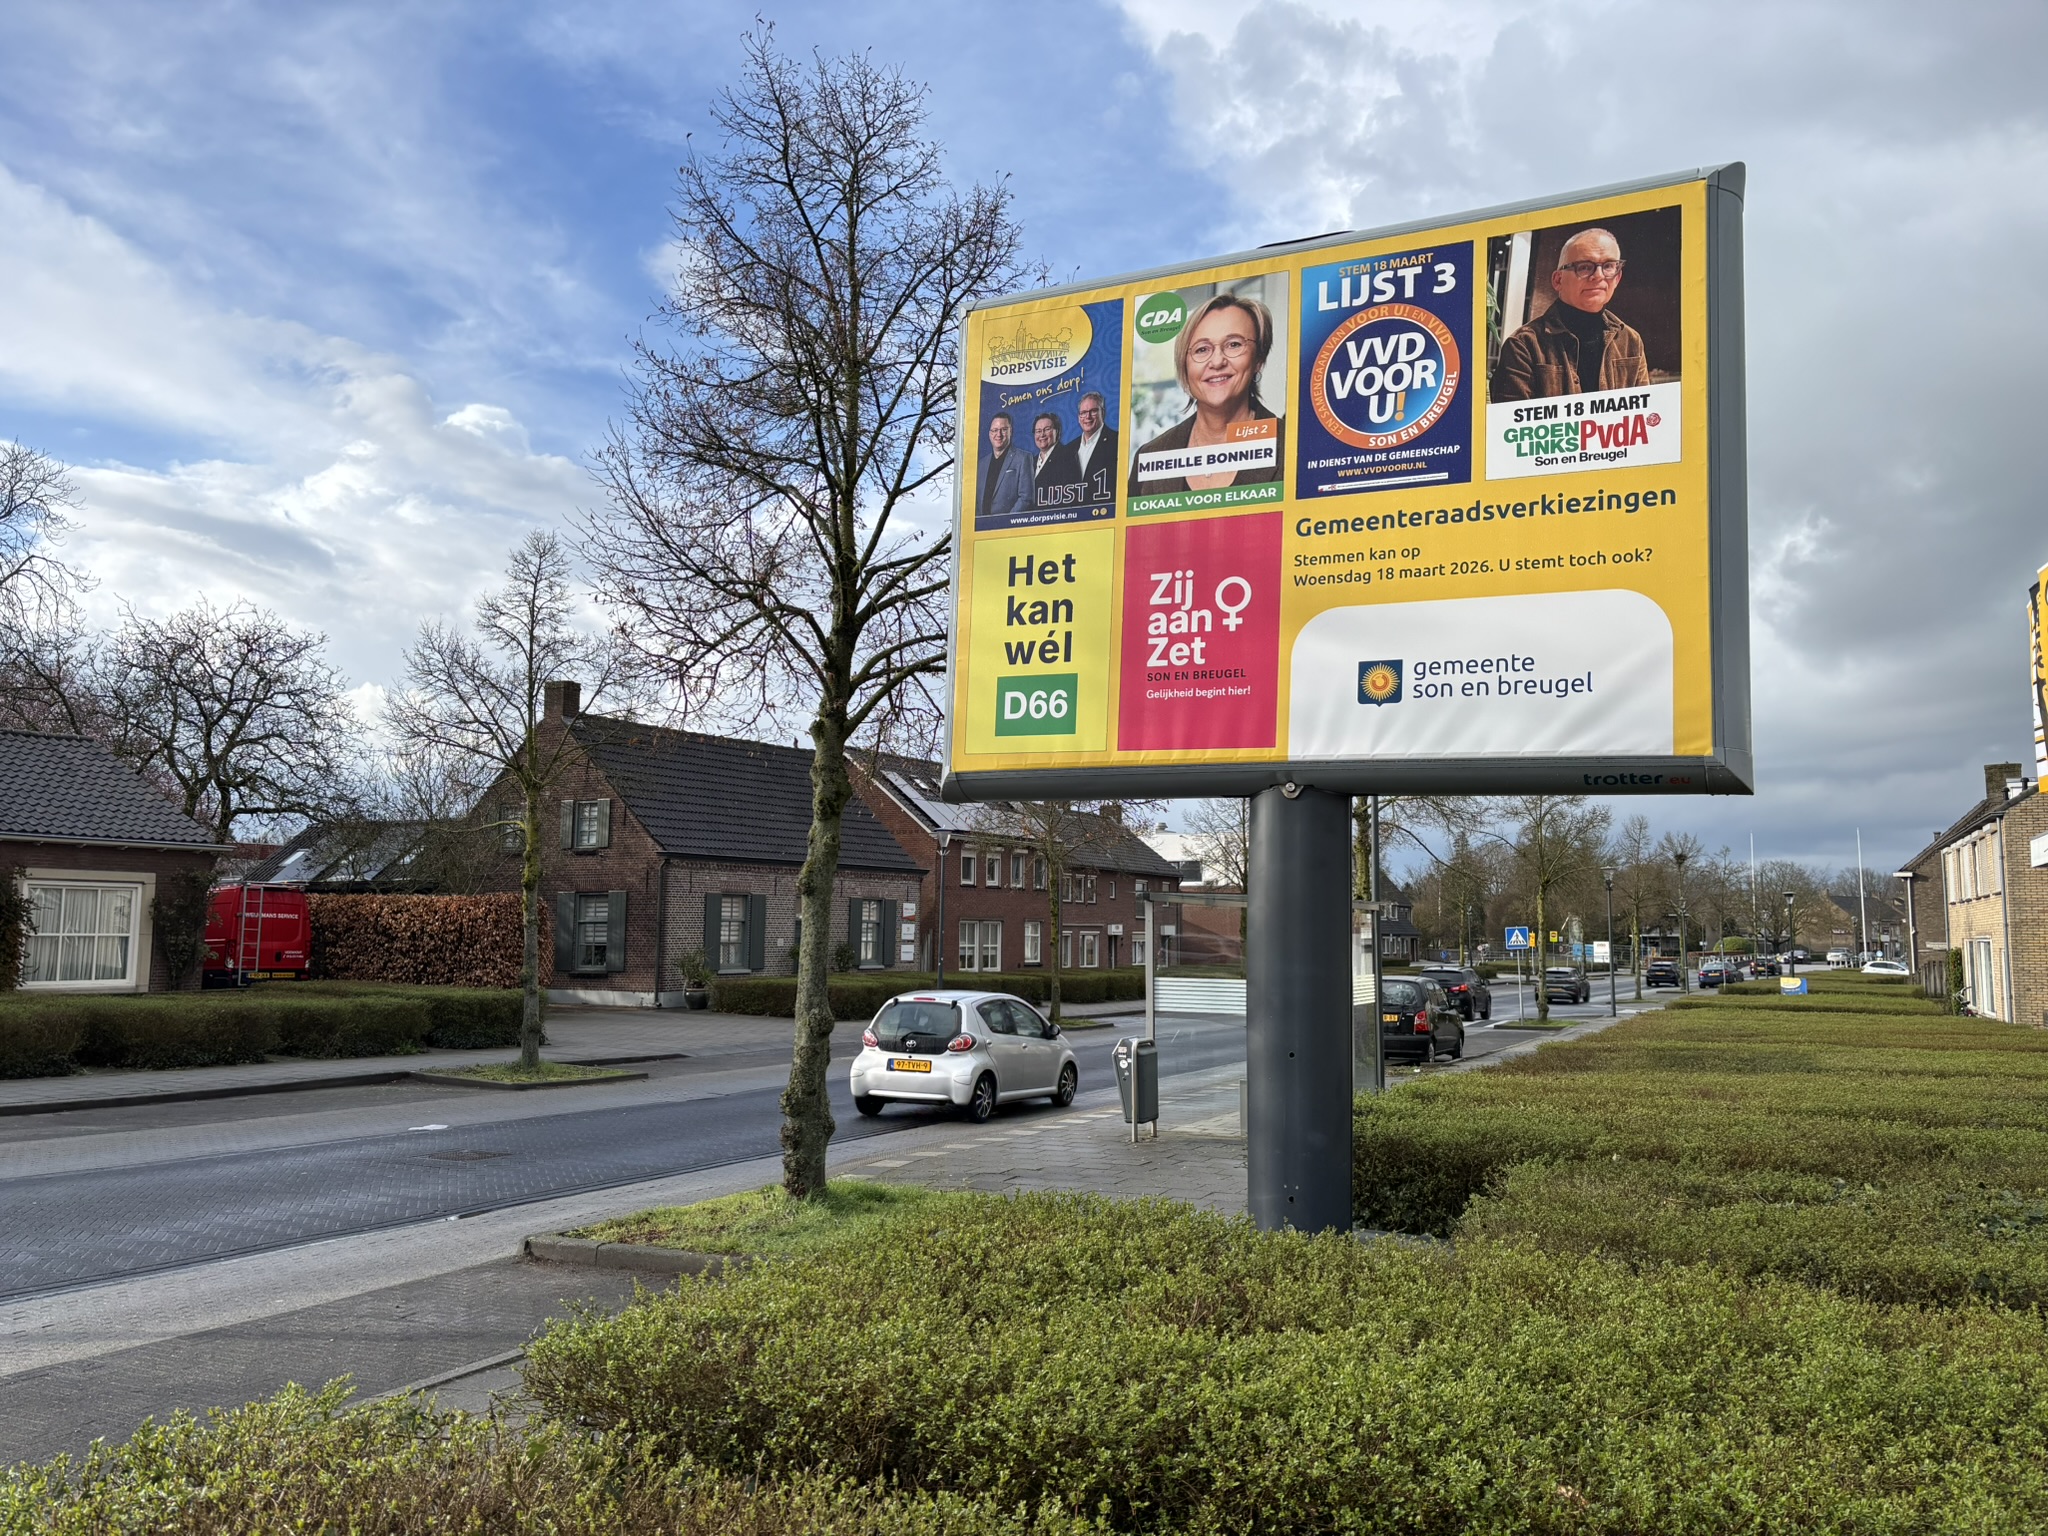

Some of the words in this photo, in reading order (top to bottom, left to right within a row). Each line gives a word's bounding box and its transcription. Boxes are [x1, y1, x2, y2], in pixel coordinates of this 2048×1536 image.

[1339, 262, 1371, 277] STEM
[1373, 259, 1387, 272] 18
[1388, 252, 1434, 269] MAART
[1318, 265, 1423, 311] LIJST
[1432, 262, 1456, 294] 3
[1140, 307, 1182, 328] CDA
[1346, 305, 1389, 331] VOOR
[1394, 305, 1410, 316] U!
[1412, 309, 1427, 322] EN
[1326, 329, 1346, 350] VAN
[1427, 317, 1452, 345] VVD
[1346, 331, 1426, 369] VVD
[991, 356, 1068, 377] DORPSVISIE
[1330, 358, 1437, 400] VOOR
[1000, 390, 1032, 408] Samen
[1036, 384, 1054, 398] ons
[1056, 366, 1085, 393] dorp!
[1313, 350, 1331, 418] SAMENGAAN
[1368, 434, 1398, 447] SON
[1401, 425, 1419, 441] EN
[1421, 370, 1457, 429] BREUGEL
[1369, 391, 1406, 424] U!
[1513, 404, 1559, 422] STEM
[1563, 401, 1585, 417] 18
[1589, 393, 1651, 413] MAART
[1235, 425, 1259, 438] Lijst
[1260, 424, 1268, 434] 2
[1326, 418, 1343, 436] EEN
[1503, 421, 1580, 443] GROEN
[1580, 413, 1649, 451] PvdA
[1139, 453, 1204, 473] MIREILLE
[1206, 447, 1274, 465] BONNIER
[1307, 460, 1318, 470] IN
[1319, 456, 1352, 468] DIENST
[1353, 454, 1373, 464] VAN
[1376, 452, 1387, 462] DE
[1388, 445, 1461, 460] GEMEENSCHAP
[1516, 439, 1580, 457] LINKS
[1534, 453, 1558, 467] Son
[1561, 453, 1576, 463] en
[1579, 447, 1628, 465] Breugel
[1337, 461, 1428, 478] WWW.VVDVOORU.NL
[1037, 482, 1088, 507] LIJST
[1092, 468, 1111, 501] 1
[1133, 497, 1183, 511] LOKAAL
[1185, 492, 1222, 505] VOOR
[1225, 487, 1277, 502] ELKAAR
[1010, 511, 1078, 525] www.dorpsvisie.nu
[1295, 487, 1678, 537] Gemeenteraadsverkiezingen
[1293, 567, 1372, 588] Woensdag
[1376, 566, 1396, 581] 18
[1399, 563, 1446, 580] maart
[1449, 560, 1494, 577] 2026.
[1498, 558, 1511, 573] U
[1515, 554, 1565, 571] stemt
[1568, 550, 1607, 567] toch
[1611, 548, 1654, 564] ook?
[1294, 548, 1365, 567] Stemmen
[1368, 546, 1397, 561] kan
[1400, 547, 1421, 564] op
[1007, 553, 1077, 588] Het
[1149, 569, 1195, 610] Zij
[1005, 594, 1074, 627] kan
[1147, 608, 1213, 635] aan
[1004, 630, 1073, 666] wél
[1146, 636, 1206, 667] Zet
[1146, 671, 1172, 682] SON
[1174, 670, 1189, 681] EN
[1192, 668, 1247, 680] BREUGEL
[1413, 653, 1536, 680] gemeente
[1146, 687, 1194, 700] Gelijkheid
[1195, 686, 1227, 699] begint
[1228, 685, 1251, 697] hier!
[1412, 681, 1454, 700] son
[1461, 680, 1490, 698] en
[1497, 671, 1594, 699] breugel
[1003, 689, 1069, 720] D66
[896, 1060, 928, 1070] 97-TVH-9
